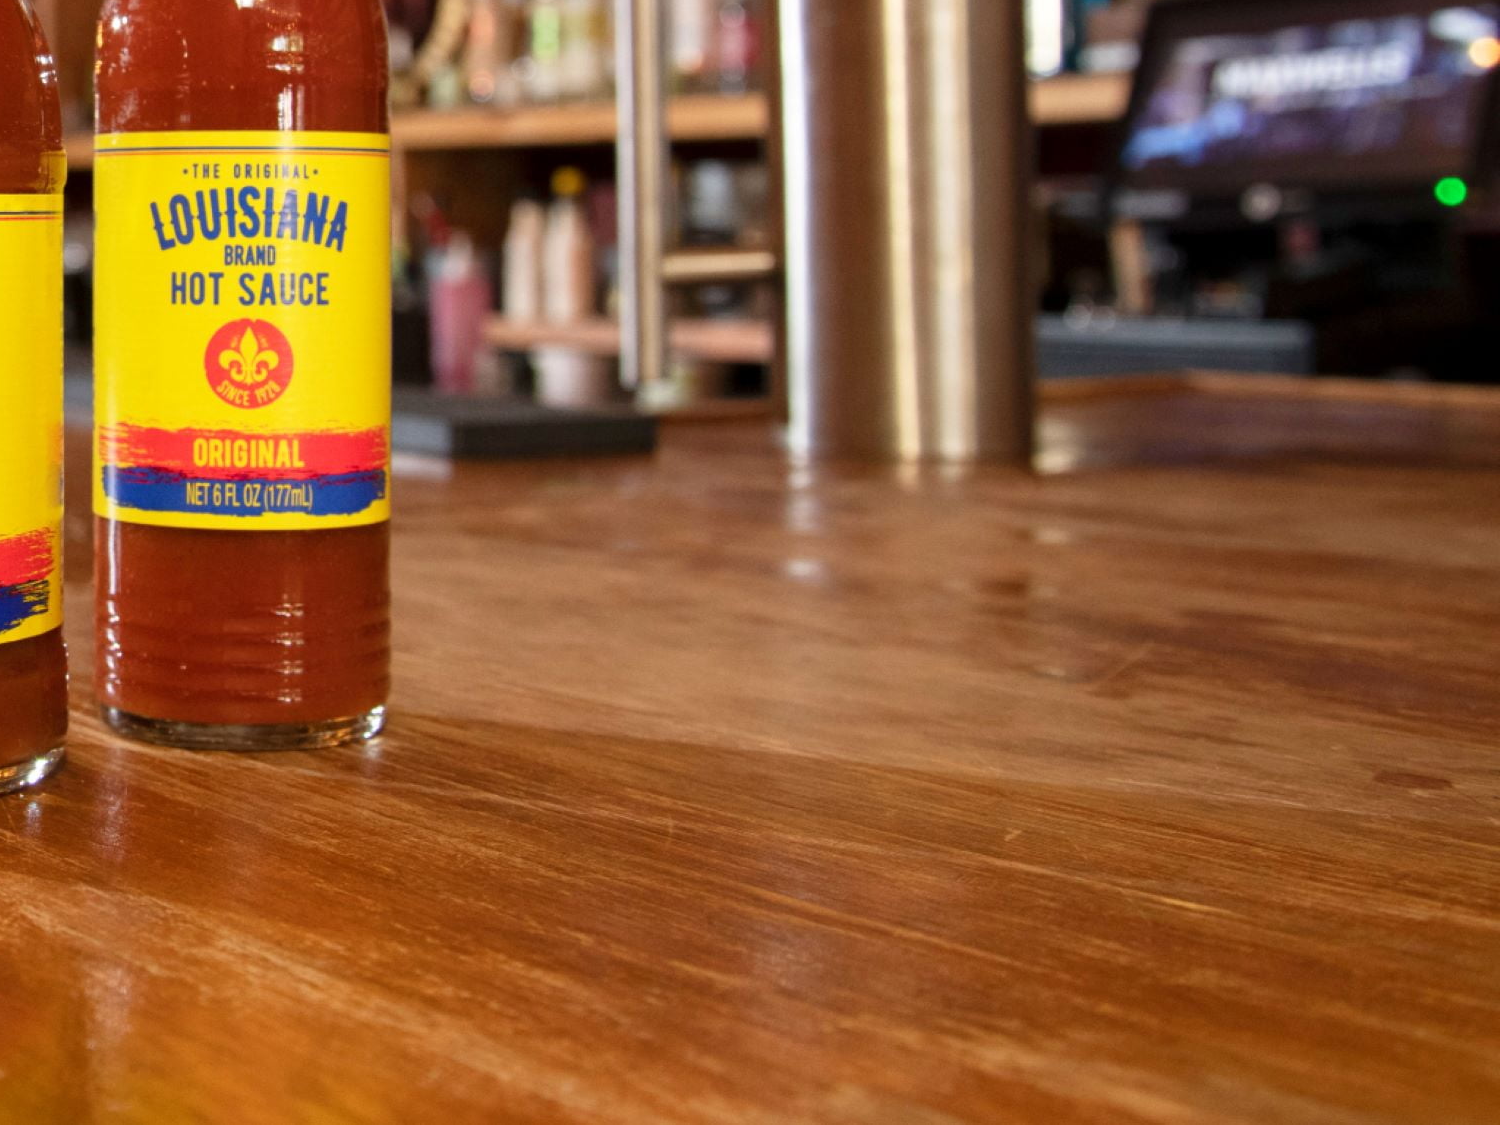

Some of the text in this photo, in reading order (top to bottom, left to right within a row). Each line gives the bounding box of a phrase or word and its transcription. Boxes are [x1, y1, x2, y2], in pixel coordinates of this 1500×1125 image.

[192, 163, 310, 179] THE ORIGINAL
[150, 185, 348, 253] LOUISIANA
[223, 244, 276, 266] BRAND
[171, 271, 330, 307] HOT SAUCE
[193, 437, 306, 468] ORIGINAL
[186, 482, 313, 511] NET 6 FL OZ (177mL)
